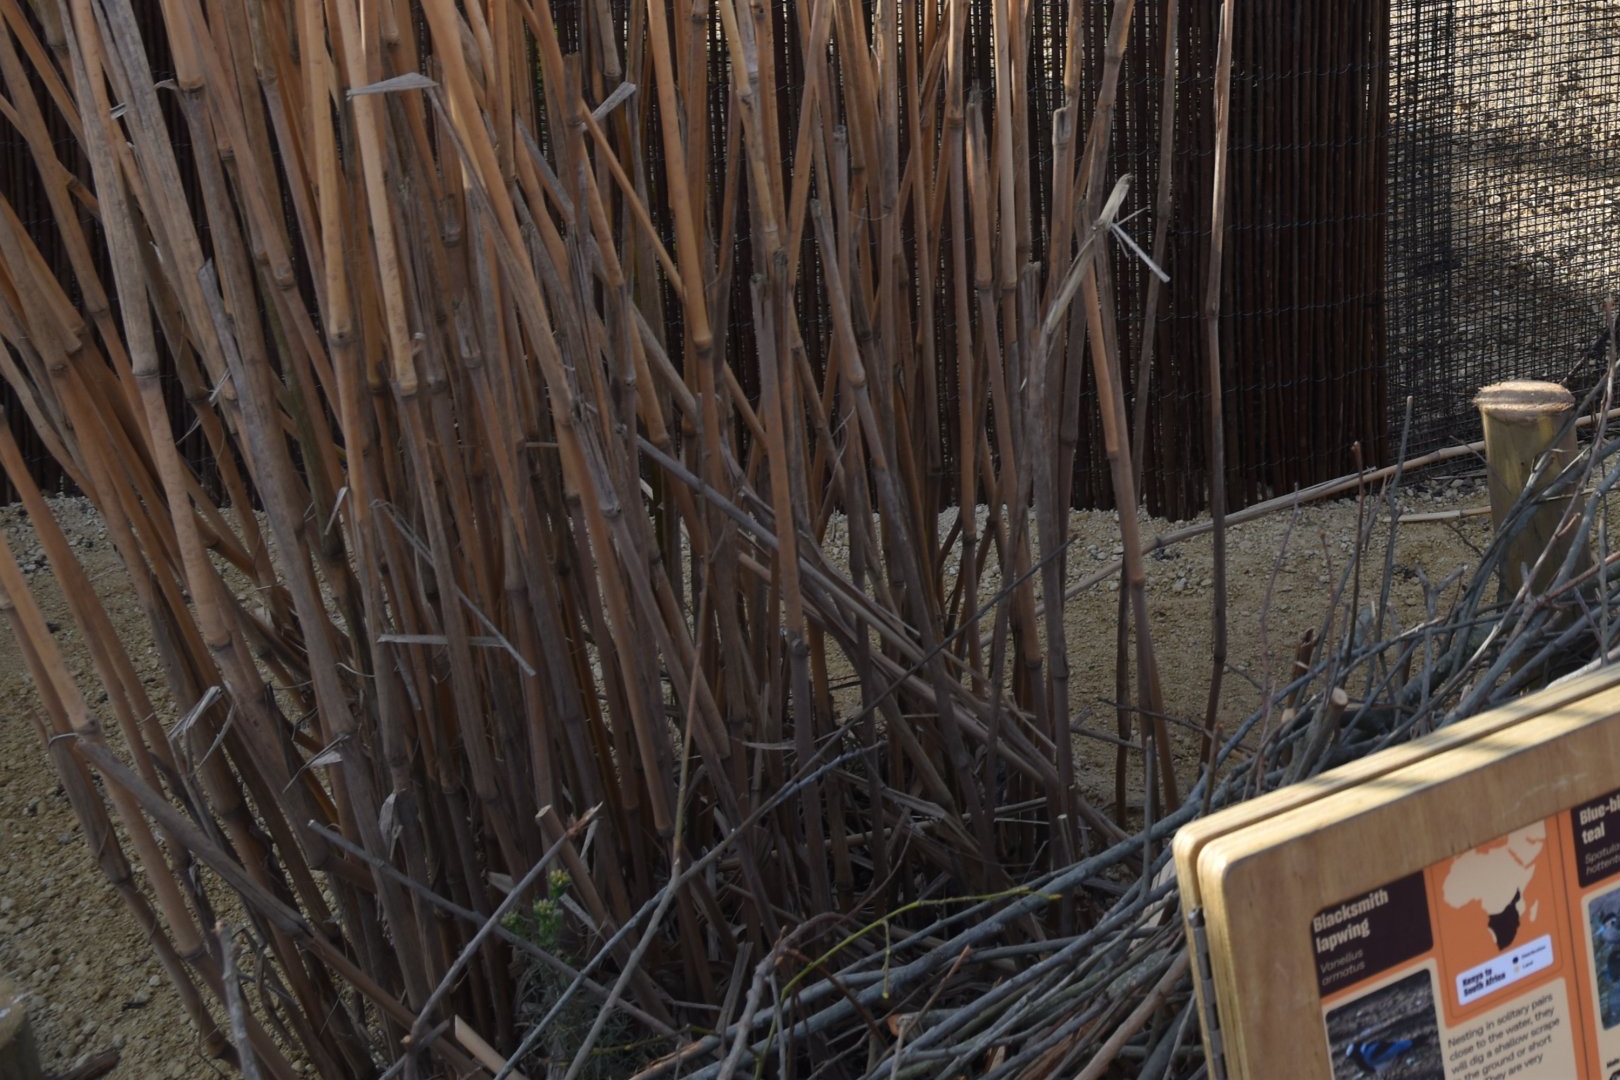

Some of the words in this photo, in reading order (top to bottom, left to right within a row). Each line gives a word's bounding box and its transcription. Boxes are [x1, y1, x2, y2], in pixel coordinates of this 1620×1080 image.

[1582, 821, 1606, 845] teal
[1584, 842, 1620, 865] Spatula
[1312, 888, 1389, 933] Blacksmith
[1316, 918, 1371, 954] lapwing
[1320, 949, 1364, 974] Vanellus
[1321, 961, 1366, 986] armatus
[1448, 1026, 1484, 1048] Nesting
[1486, 1021, 1495, 1032] in
[1496, 1006, 1530, 1026] solitary
[1531, 994, 1553, 1011] pairs
[1449, 1045, 1474, 1061] close
[1476, 1038, 1486, 1050] to
[1488, 1031, 1504, 1044] the
[1535, 1006, 1555, 1022] they
[1451, 1061, 1468, 1075] will
[1469, 1053, 1485, 1067] dig
[1486, 1049, 1493, 1059] a
[1494, 1033, 1529, 1054] shallow
[1530, 1018, 1560, 1038] scrape
[1481, 1052, 1515, 1077] ground
[1516, 1048, 1526, 1059] or
[1528, 1034, 1552, 1052] short
[1508, 1065, 1523, 1076] are
[1524, 1053, 1543, 1069] very
